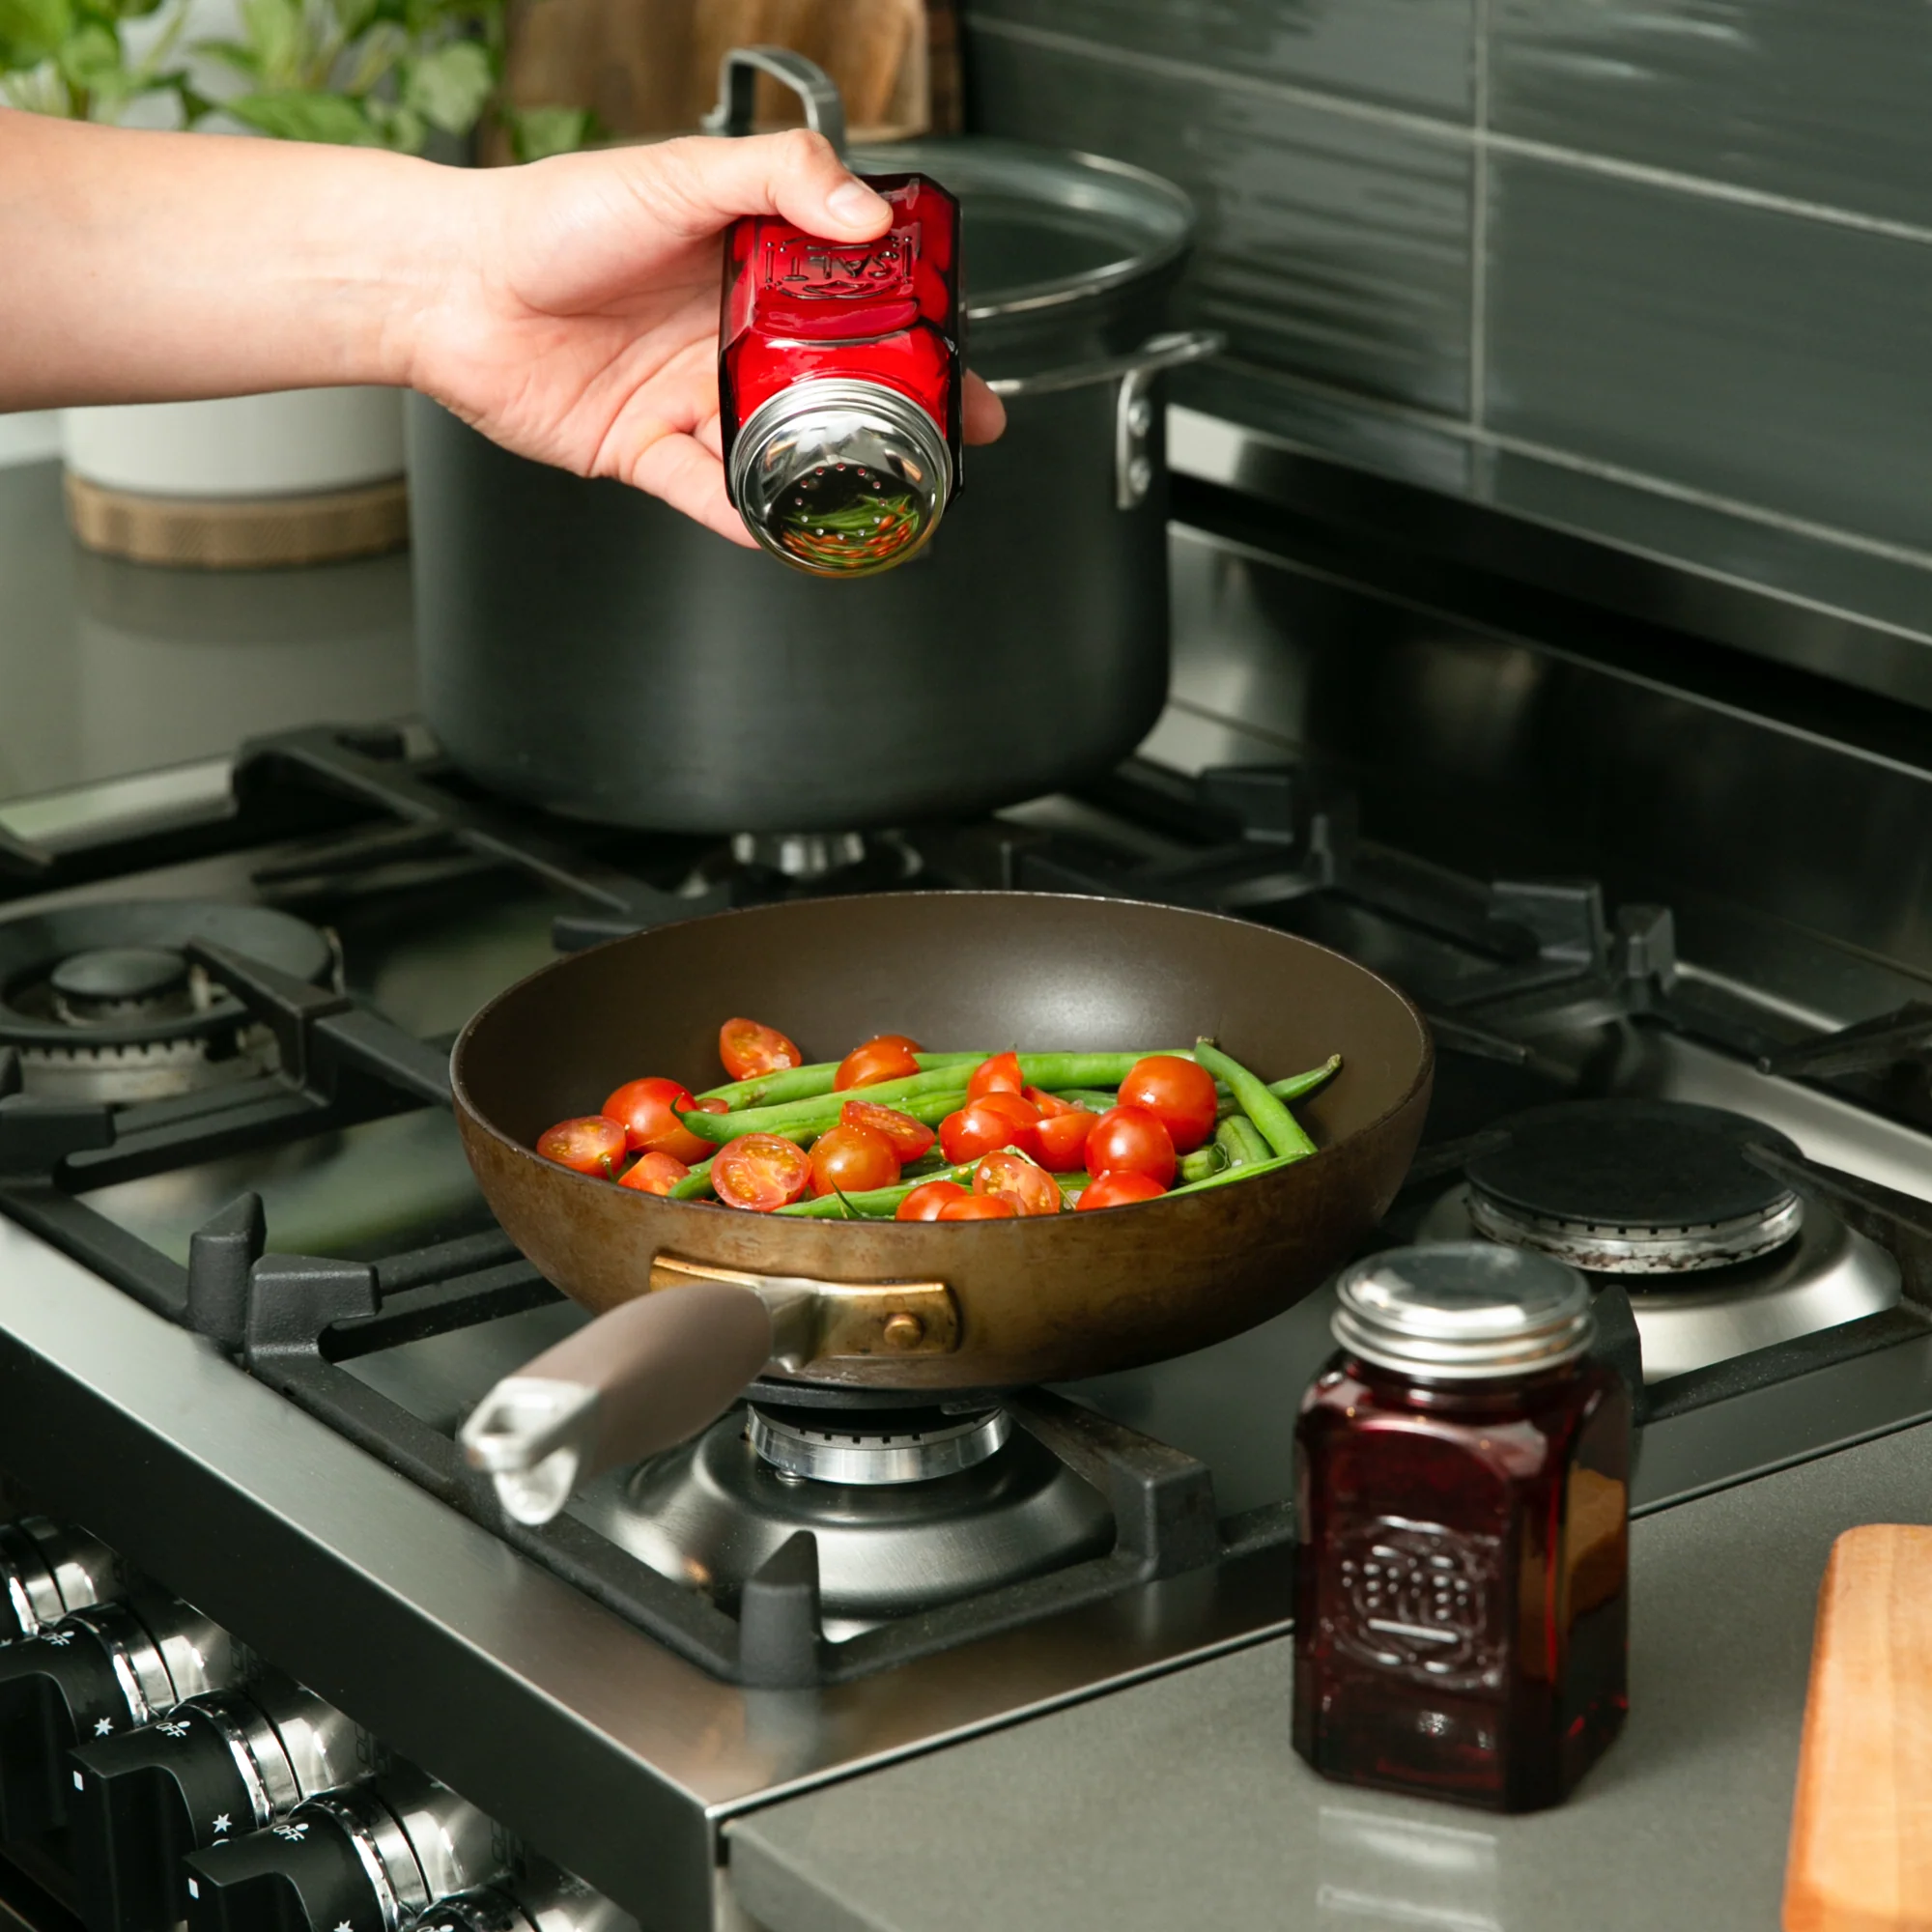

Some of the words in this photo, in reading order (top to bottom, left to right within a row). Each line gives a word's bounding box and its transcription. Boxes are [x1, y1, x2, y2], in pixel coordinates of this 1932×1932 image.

[782, 251, 899, 281] SALT
[156, 1721, 187, 1738] OFF
[272, 1825, 305, 1841] OFF
